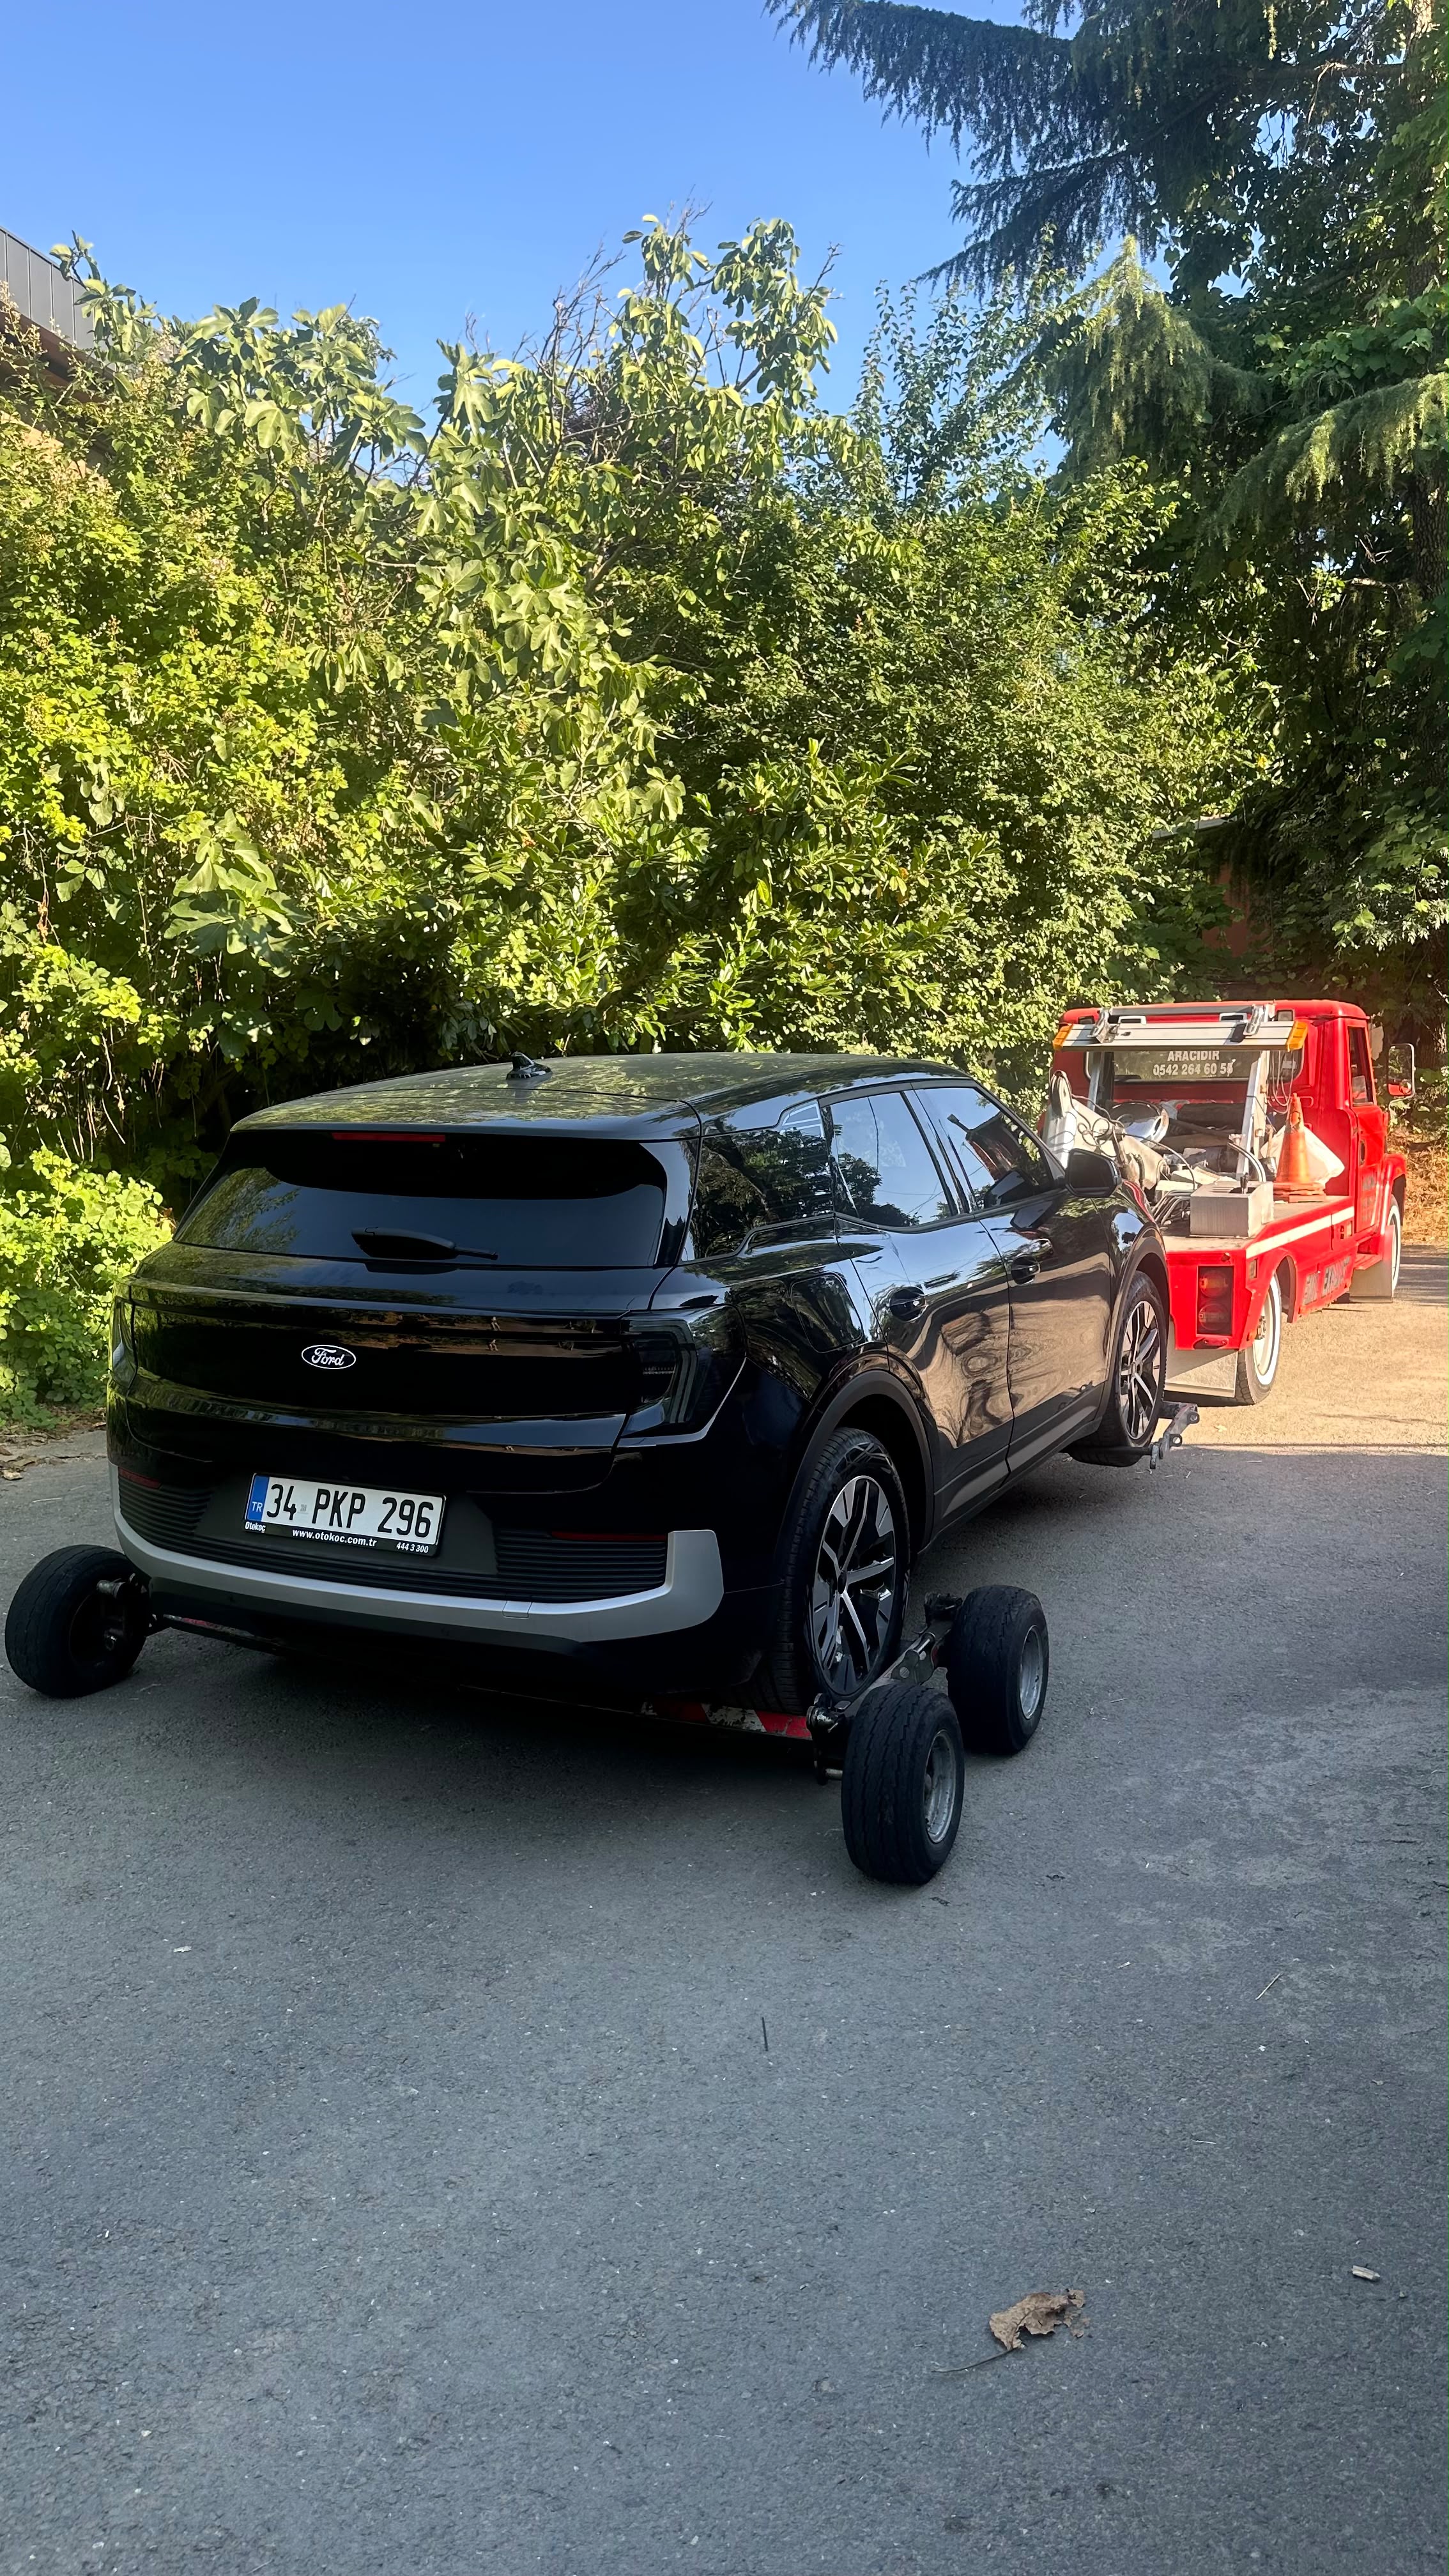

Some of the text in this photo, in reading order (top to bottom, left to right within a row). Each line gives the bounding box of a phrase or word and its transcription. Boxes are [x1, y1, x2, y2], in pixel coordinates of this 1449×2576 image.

[1153, 1064, 1179, 1076] 0542
[1181, 1063, 1201, 1075] 264
[1204, 1062, 1217, 1075] 60
[310, 1347, 346, 1367] Ford
[252, 1501, 263, 1513] TR
[266, 1483, 434, 1538] 34 PKP 296
[245, 1521, 266, 1533] Otokoç
[292, 1529, 378, 1547] www.otokoc.com.tr
[396, 1542, 409, 1551] 444
[415, 1545, 429, 1554] 300
